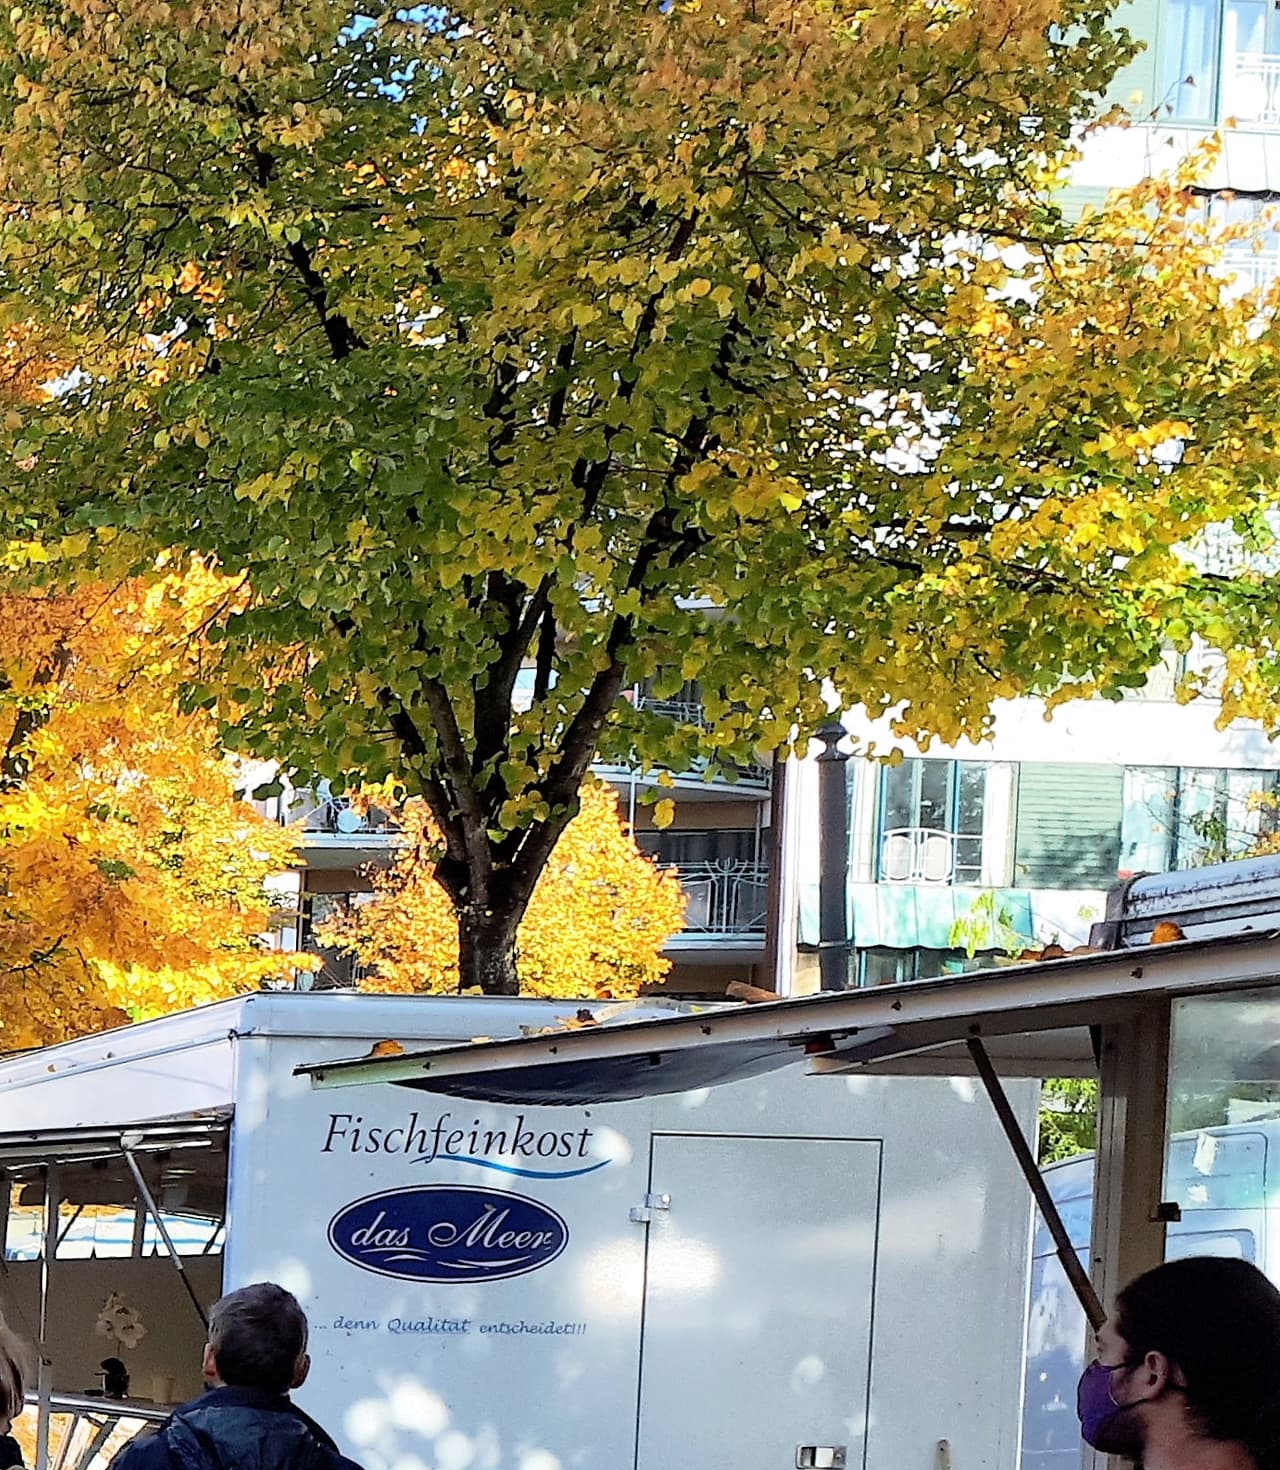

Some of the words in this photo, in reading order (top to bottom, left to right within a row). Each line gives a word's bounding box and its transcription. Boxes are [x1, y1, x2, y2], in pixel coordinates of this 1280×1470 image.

[320, 1112, 594, 1164] Fischfeinkost
[351, 1211, 411, 1247] das
[428, 1206, 554, 1250] Meer
[333, 1315, 380, 1330] denn
